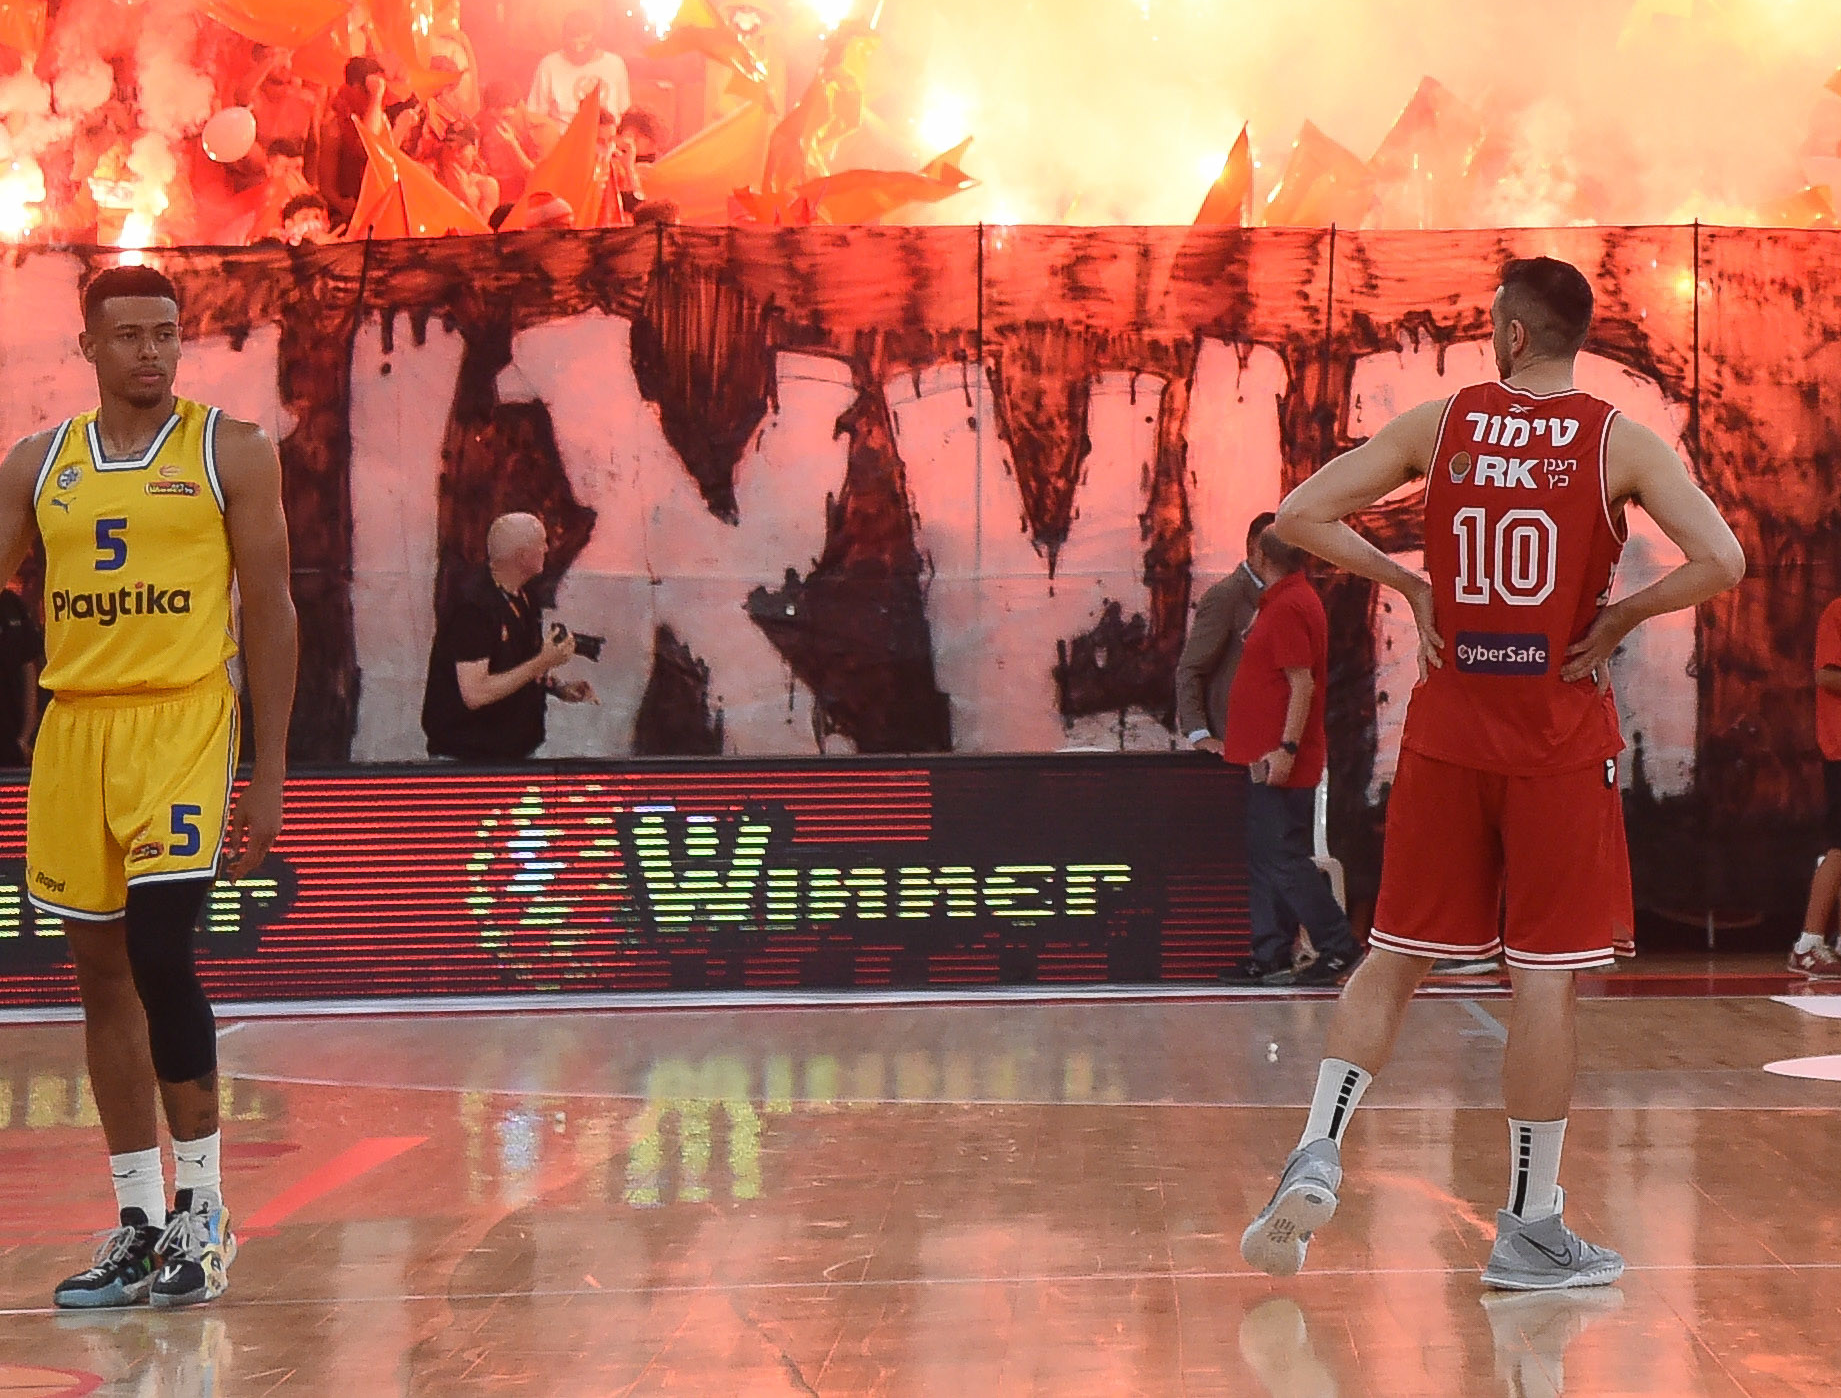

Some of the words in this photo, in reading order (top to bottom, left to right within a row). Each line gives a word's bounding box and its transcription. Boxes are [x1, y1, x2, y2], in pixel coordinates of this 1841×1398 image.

[1465, 412, 1580, 448] טימור
[1473, 454, 1540, 489] RK
[1543, 457, 1578, 473] רענן
[1547, 473, 1570, 489] כץ
[94, 516, 129, 571] 5
[1452, 507, 1558, 606] 10
[52, 580, 192, 627] Playtika
[1457, 644, 1547, 666] CyberSafe
[168, 803, 202, 857] 5
[34, 871, 67, 893] Rapyd
[632, 806, 1132, 922] Winner
